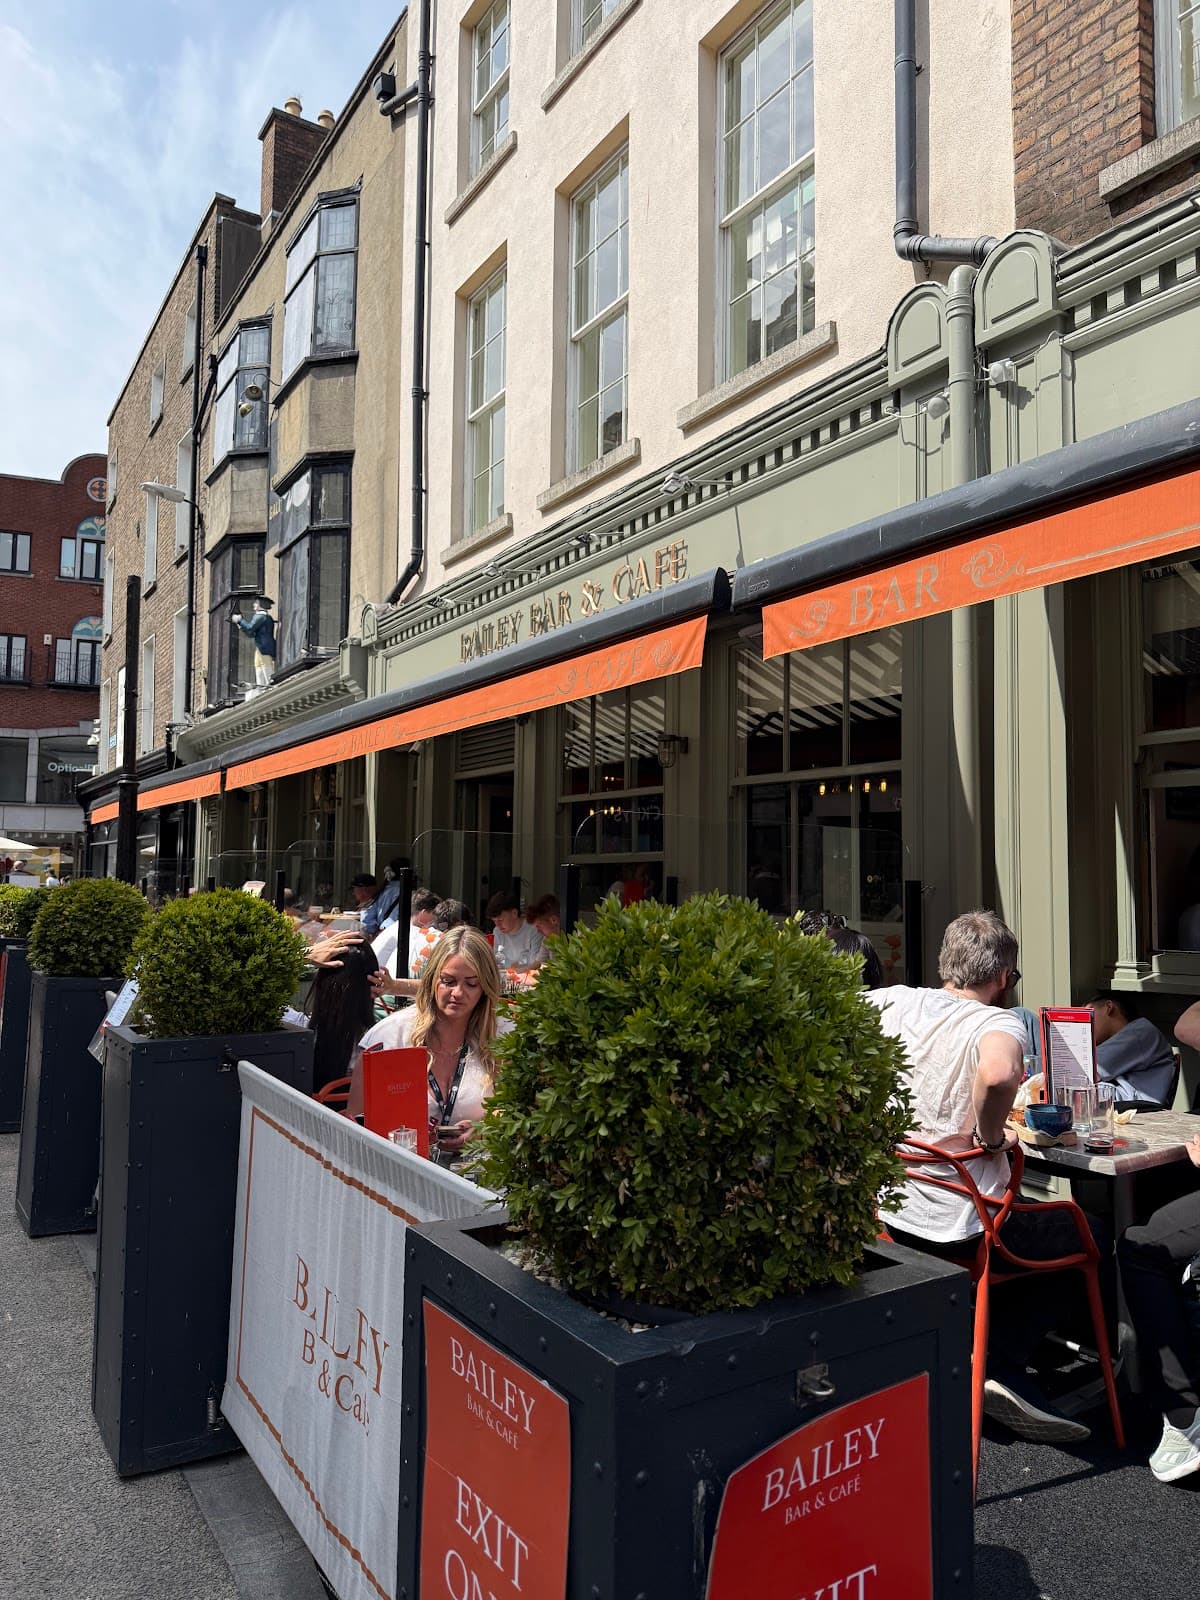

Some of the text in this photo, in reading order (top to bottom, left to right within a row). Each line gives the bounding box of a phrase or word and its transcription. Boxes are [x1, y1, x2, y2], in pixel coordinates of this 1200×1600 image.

[459, 609, 523, 663] BAILEY
[528, 590, 571, 637] BAR
[580, 579, 603, 617] &
[848, 564, 941, 626] BAR
[318, 1359, 332, 1398] &
[449, 1336, 536, 1434] BAILEY
[467, 1393, 484, 1421] BAR
[486, 1410, 494, 1430] &
[761, 1418, 885, 1512] BAILEY
[784, 1473, 862, 1525] BAR & CAFÉ
[455, 1475, 529, 1592] EXIT
